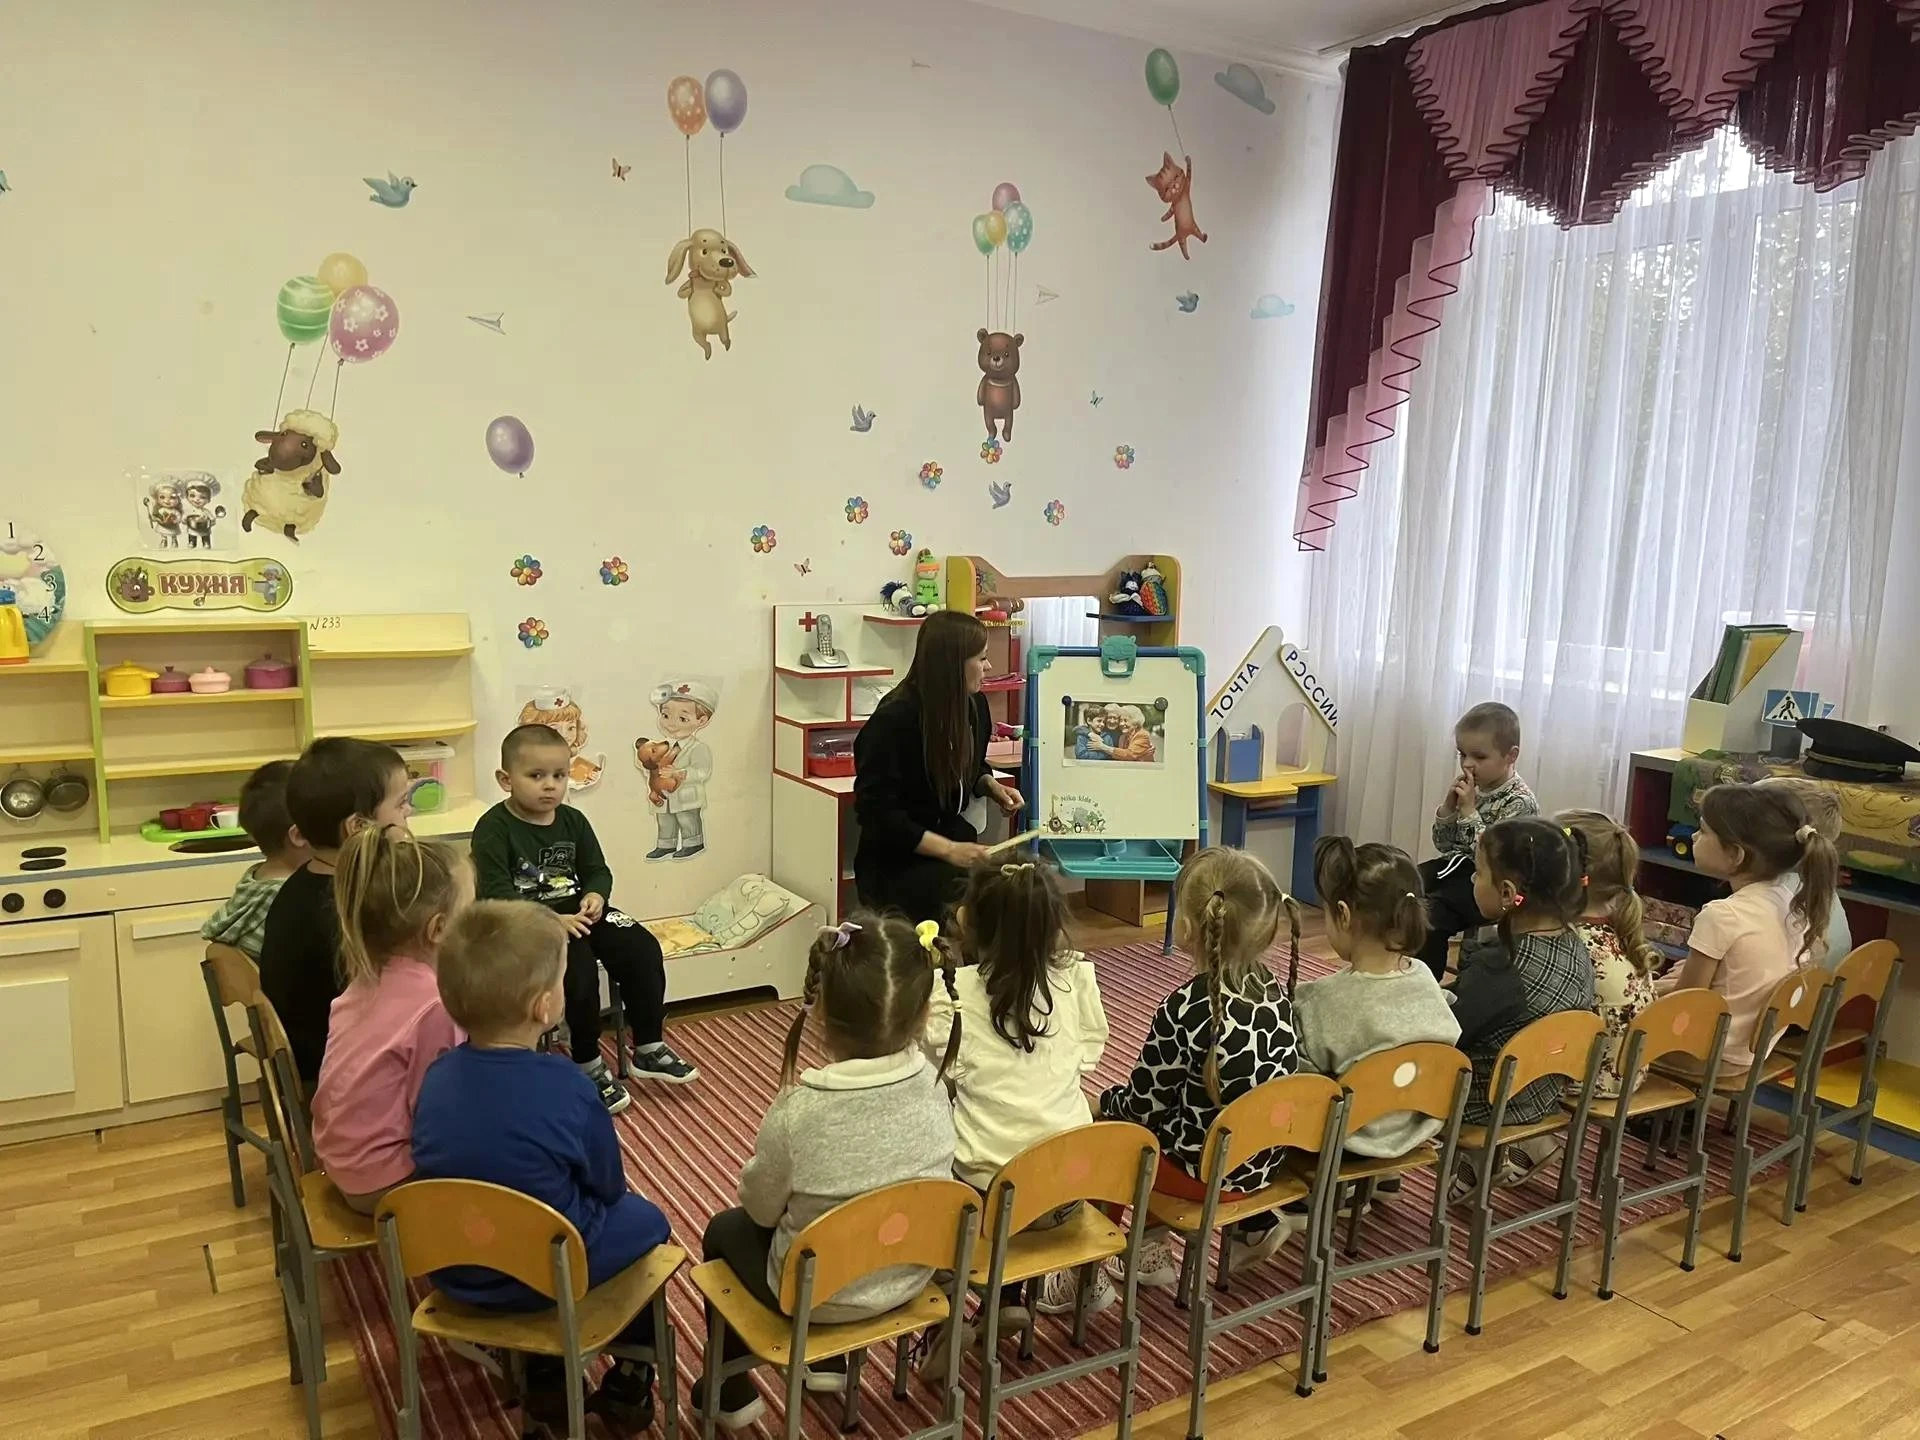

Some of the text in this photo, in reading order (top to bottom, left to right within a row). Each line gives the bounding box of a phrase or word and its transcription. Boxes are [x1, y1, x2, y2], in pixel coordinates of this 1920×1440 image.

[8, 521, 15, 539] 1
[32, 544, 45, 561] 2
[45, 574, 56, 592] 3
[159, 573, 246, 595] КУХНЯ
[38, 606, 50, 623] 4
